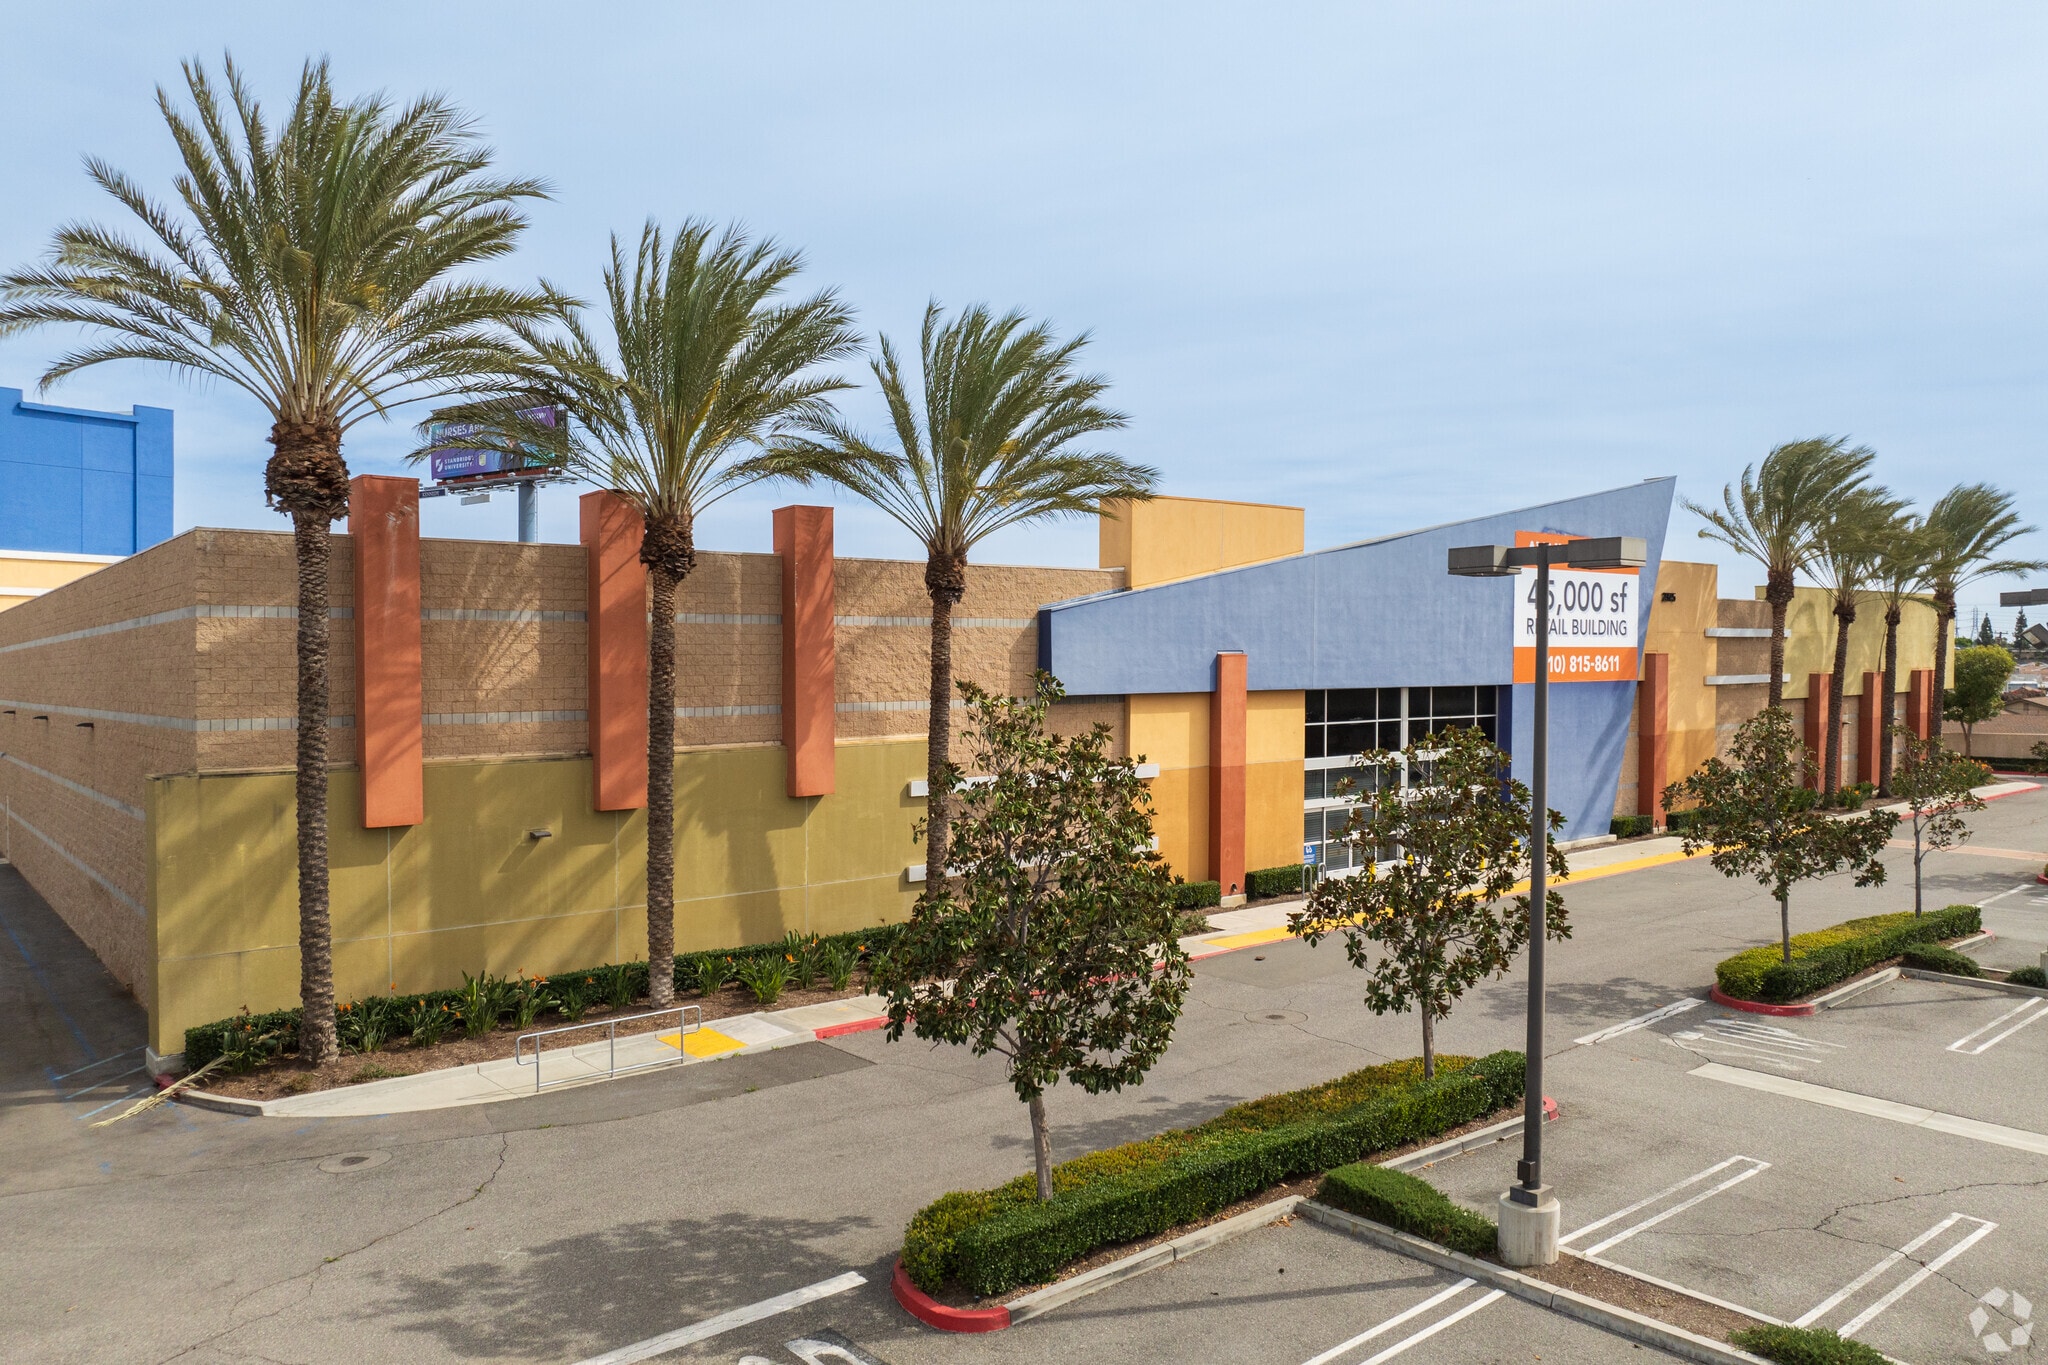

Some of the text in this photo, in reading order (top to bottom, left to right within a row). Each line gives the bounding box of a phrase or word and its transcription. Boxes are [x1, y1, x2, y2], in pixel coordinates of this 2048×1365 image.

[1610, 581, 1628, 613] sf
[1526, 618, 1627, 636] RAIL BUILDING
[1569, 655, 1620, 673] 815-8611
